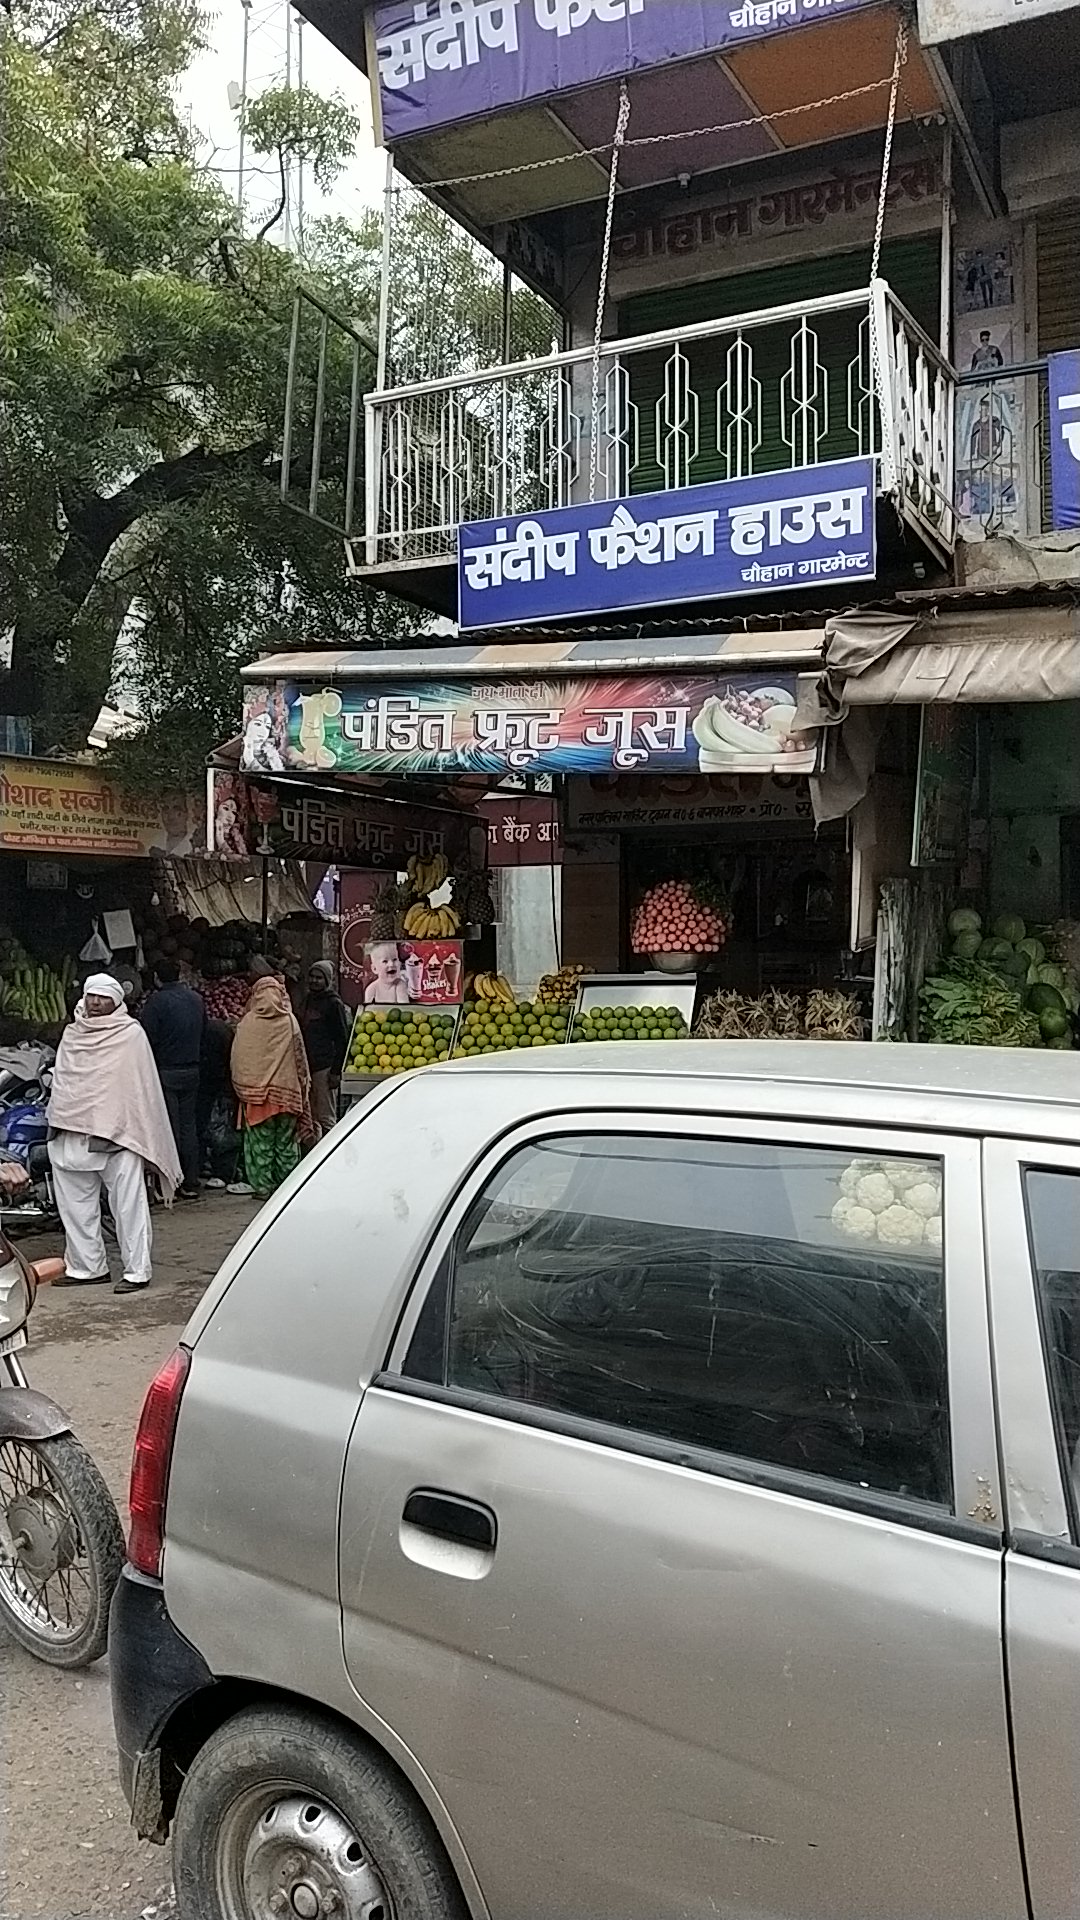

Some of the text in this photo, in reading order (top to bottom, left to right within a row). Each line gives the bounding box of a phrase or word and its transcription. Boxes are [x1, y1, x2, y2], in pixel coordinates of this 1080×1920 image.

[463, 486, 869, 591] संदीप फैशन हाउस
[741, 551, 870, 584] चौहान गारमेन्ट
[472, 681, 545, 700] जय माता दी
[341, 696, 692, 769] पंडित फ्रूट जूस
[60, 785, 115, 815] सब्जी
[281, 799, 345, 848] पंडित
[354, 818, 398, 864] फ्रूट
[502, 815, 532, 843] बैंक
